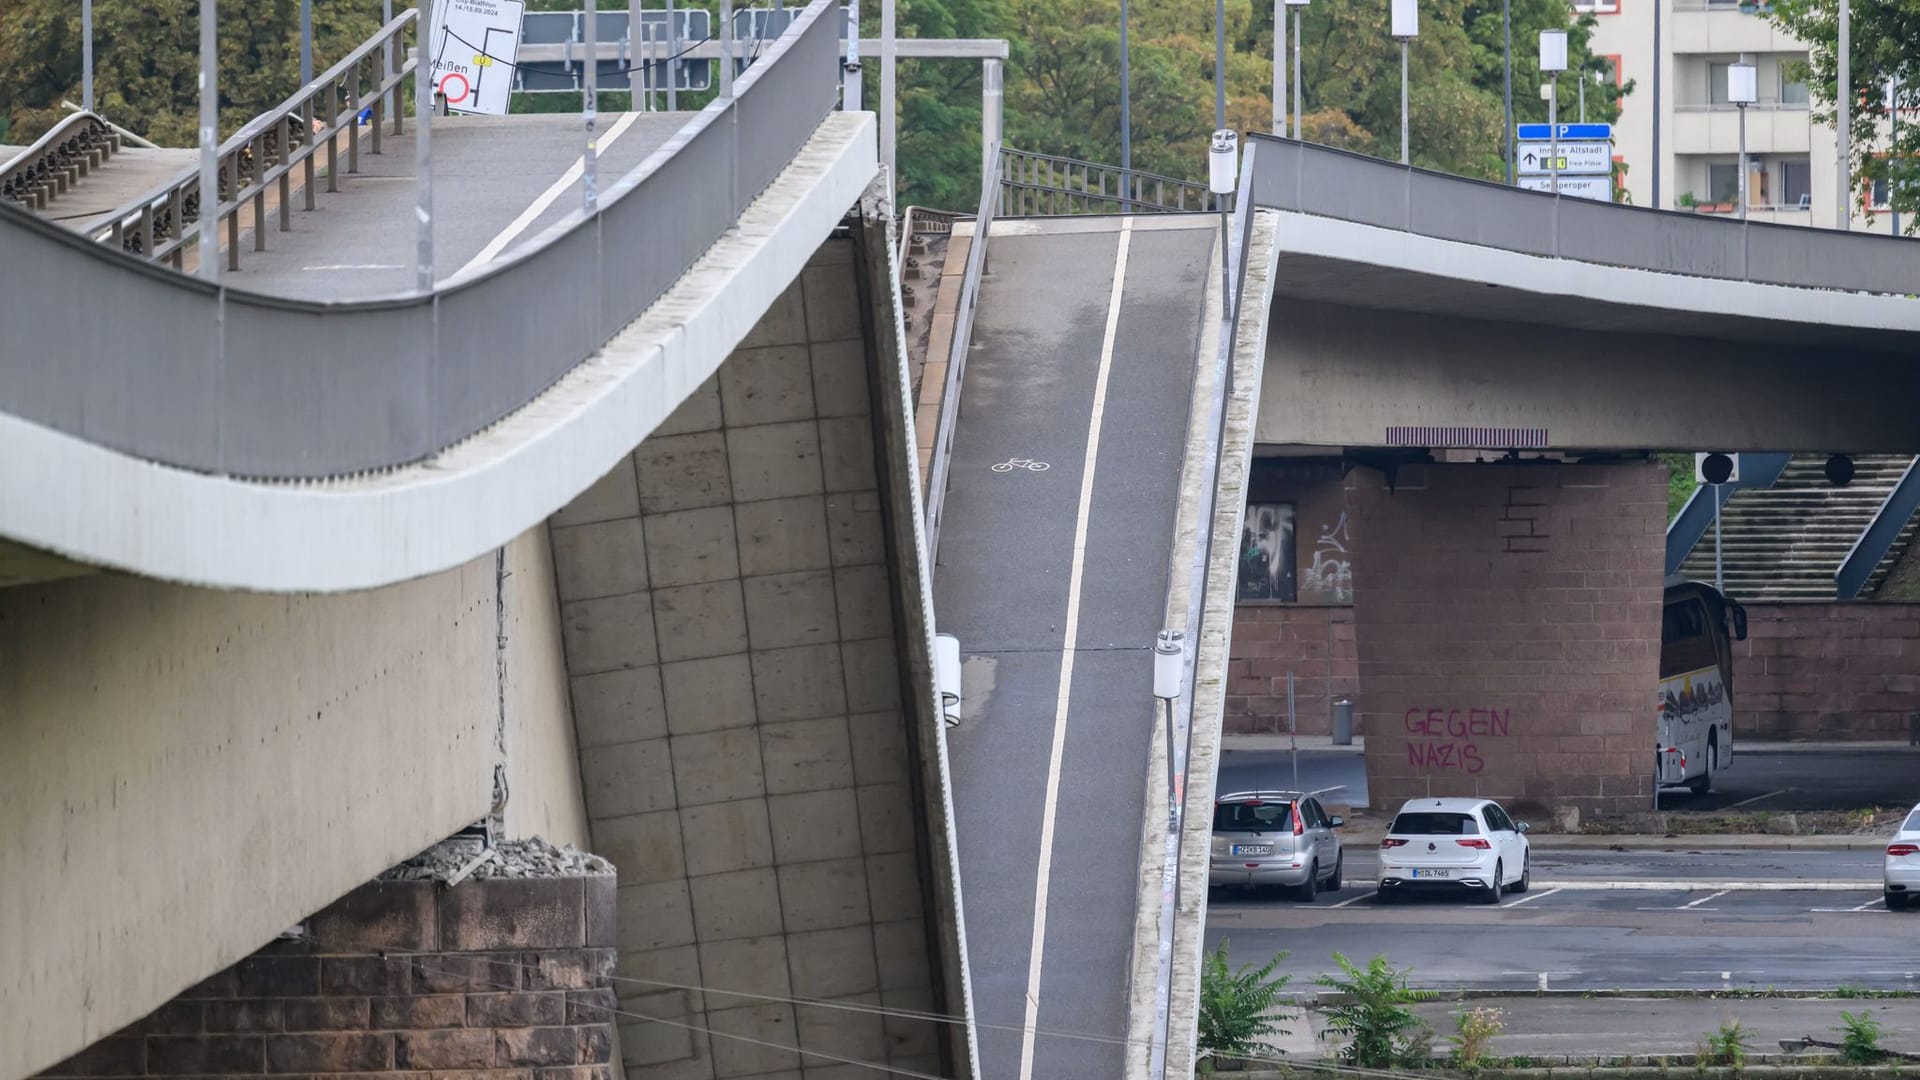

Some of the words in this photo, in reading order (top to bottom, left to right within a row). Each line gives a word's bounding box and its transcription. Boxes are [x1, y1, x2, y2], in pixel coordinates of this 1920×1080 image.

[1560, 126, 1569, 138] P
[1569, 146, 1603, 154] Altstadt
[1540, 181, 1592, 190] Seperoper
[1405, 707, 1510, 741] GEGEN
[1407, 742, 1485, 774] NAZIS
